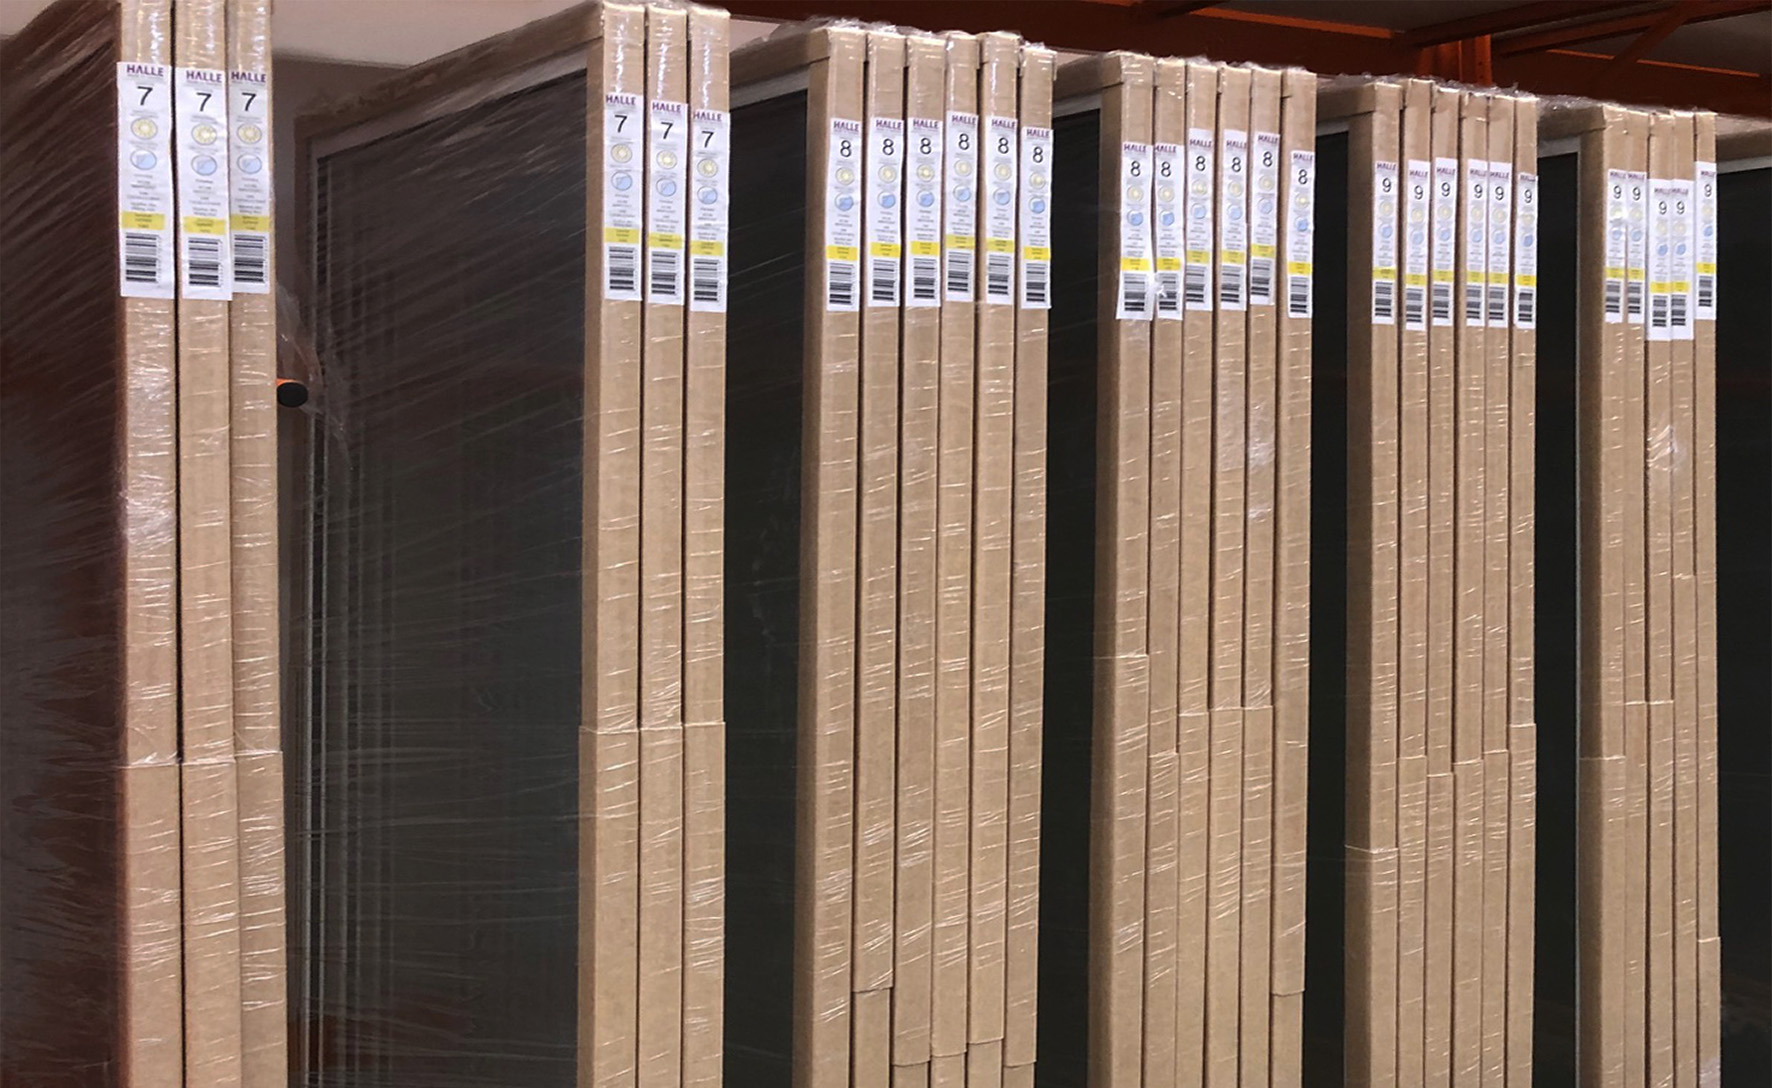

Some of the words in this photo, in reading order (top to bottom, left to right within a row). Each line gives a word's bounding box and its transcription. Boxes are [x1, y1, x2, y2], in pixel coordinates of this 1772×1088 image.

[126, 64, 164, 77] HALLE
[186, 70, 222, 83] HALLE
[231, 71, 266, 83] HALLE
[137, 86, 153, 106] 7
[196, 92, 212, 112] 7
[241, 92, 257, 112] 7
[605, 95, 636, 106] HALLE
[652, 102, 681, 113] HALLE
[614, 114, 628, 133] 7
[693, 112, 722, 122] HALLE
[913, 119, 939, 129] HALLE
[952, 114, 977, 125] HALLE
[991, 119, 1016, 129] HALLE
[661, 121, 674, 140] 7
[833, 121, 860, 131] HALLE
[876, 120, 902, 130] HALLE
[701, 130, 714, 148] 7
[1026, 129, 1050, 138] HALLE
[840, 140, 852, 158] 8
[882, 138, 894, 156] 8
[920, 137, 932, 155] 8
[958, 133, 970, 151] 8
[998, 137, 1009, 154] 8
[1032, 146, 1044, 163] 8
[1263, 151, 1273, 168] 8
[1130, 160, 1141, 177] 8
[1160, 161, 1172, 178] 8
[1195, 155, 1206, 172] 8
[1231, 156, 1242, 173] 8
[1298, 168, 1309, 185] 8
[1382, 177, 1392, 193] 9
[1414, 185, 1424, 200] 9
[1441, 182, 1451, 197] 9
[1474, 184, 1483, 199] 9
[1613, 185, 1622, 199] 9
[1704, 183, 1712, 198] 9
[1495, 186, 1504, 201] 9
[1524, 189, 1533, 203] 9
[1632, 186, 1641, 201] 9
[1658, 201, 1667, 215] 9
[1676, 200, 1685, 215] 9
